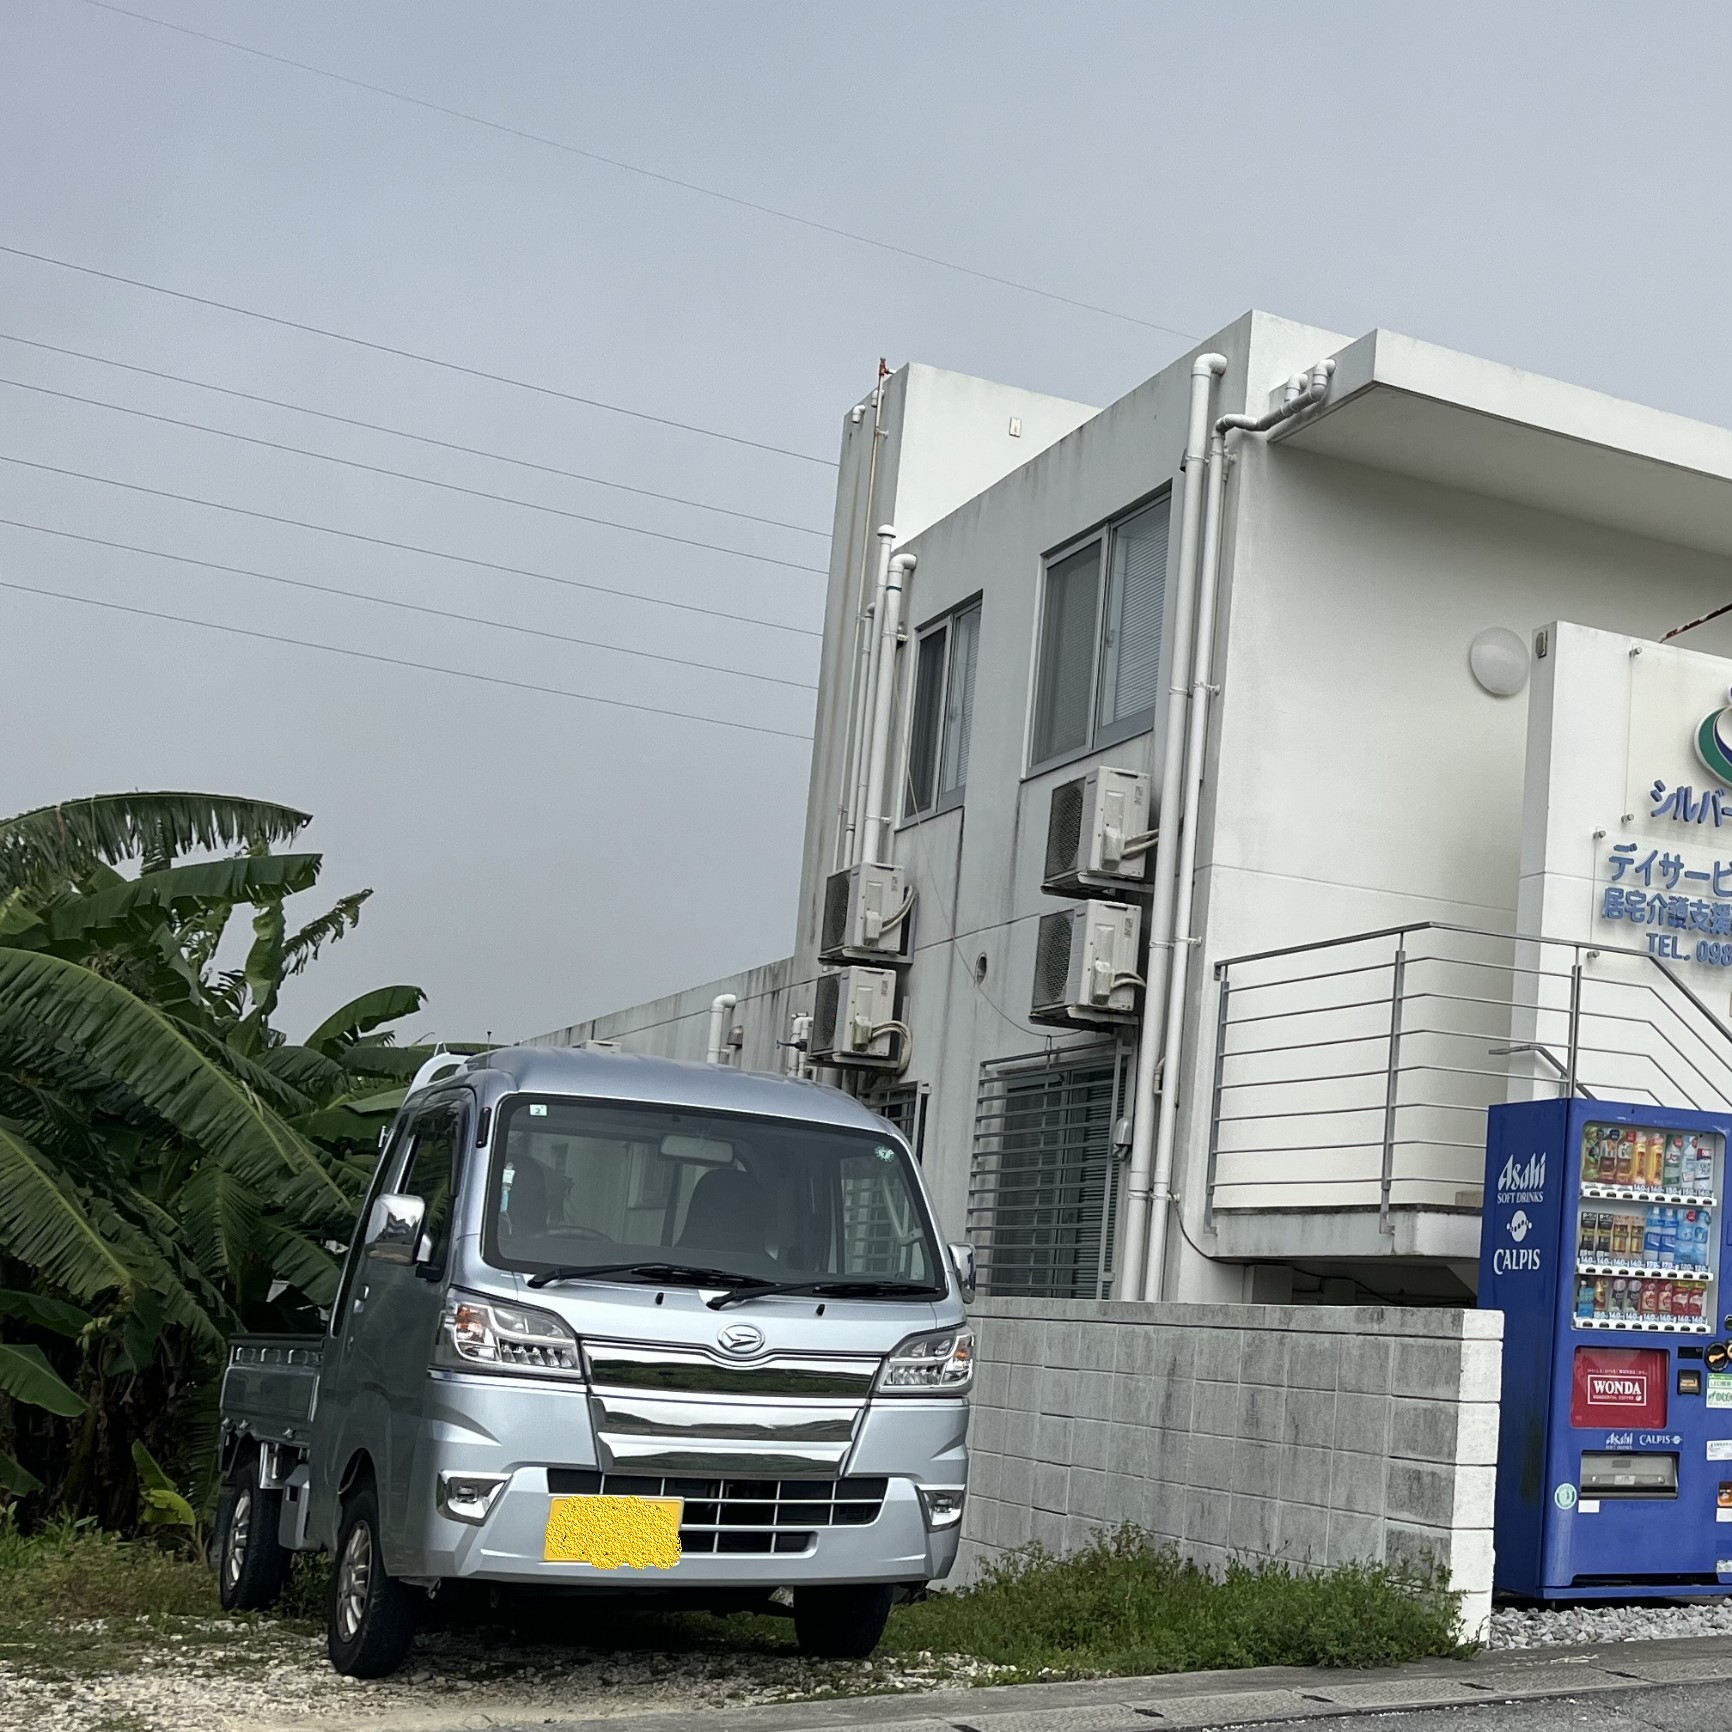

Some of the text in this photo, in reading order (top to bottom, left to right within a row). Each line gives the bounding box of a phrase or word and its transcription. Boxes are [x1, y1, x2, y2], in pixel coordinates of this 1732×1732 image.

[1646, 932, 1690, 962] TEL.
[1498, 1152, 1546, 1191] Asahi
[1497, 1191, 1544, 1204] SOFT DRINKS
[1493, 1248, 1541, 1275] CALPIS
[1593, 1380, 1642, 1395] WONDA
[1639, 1434, 1671, 1446] CALPIS
